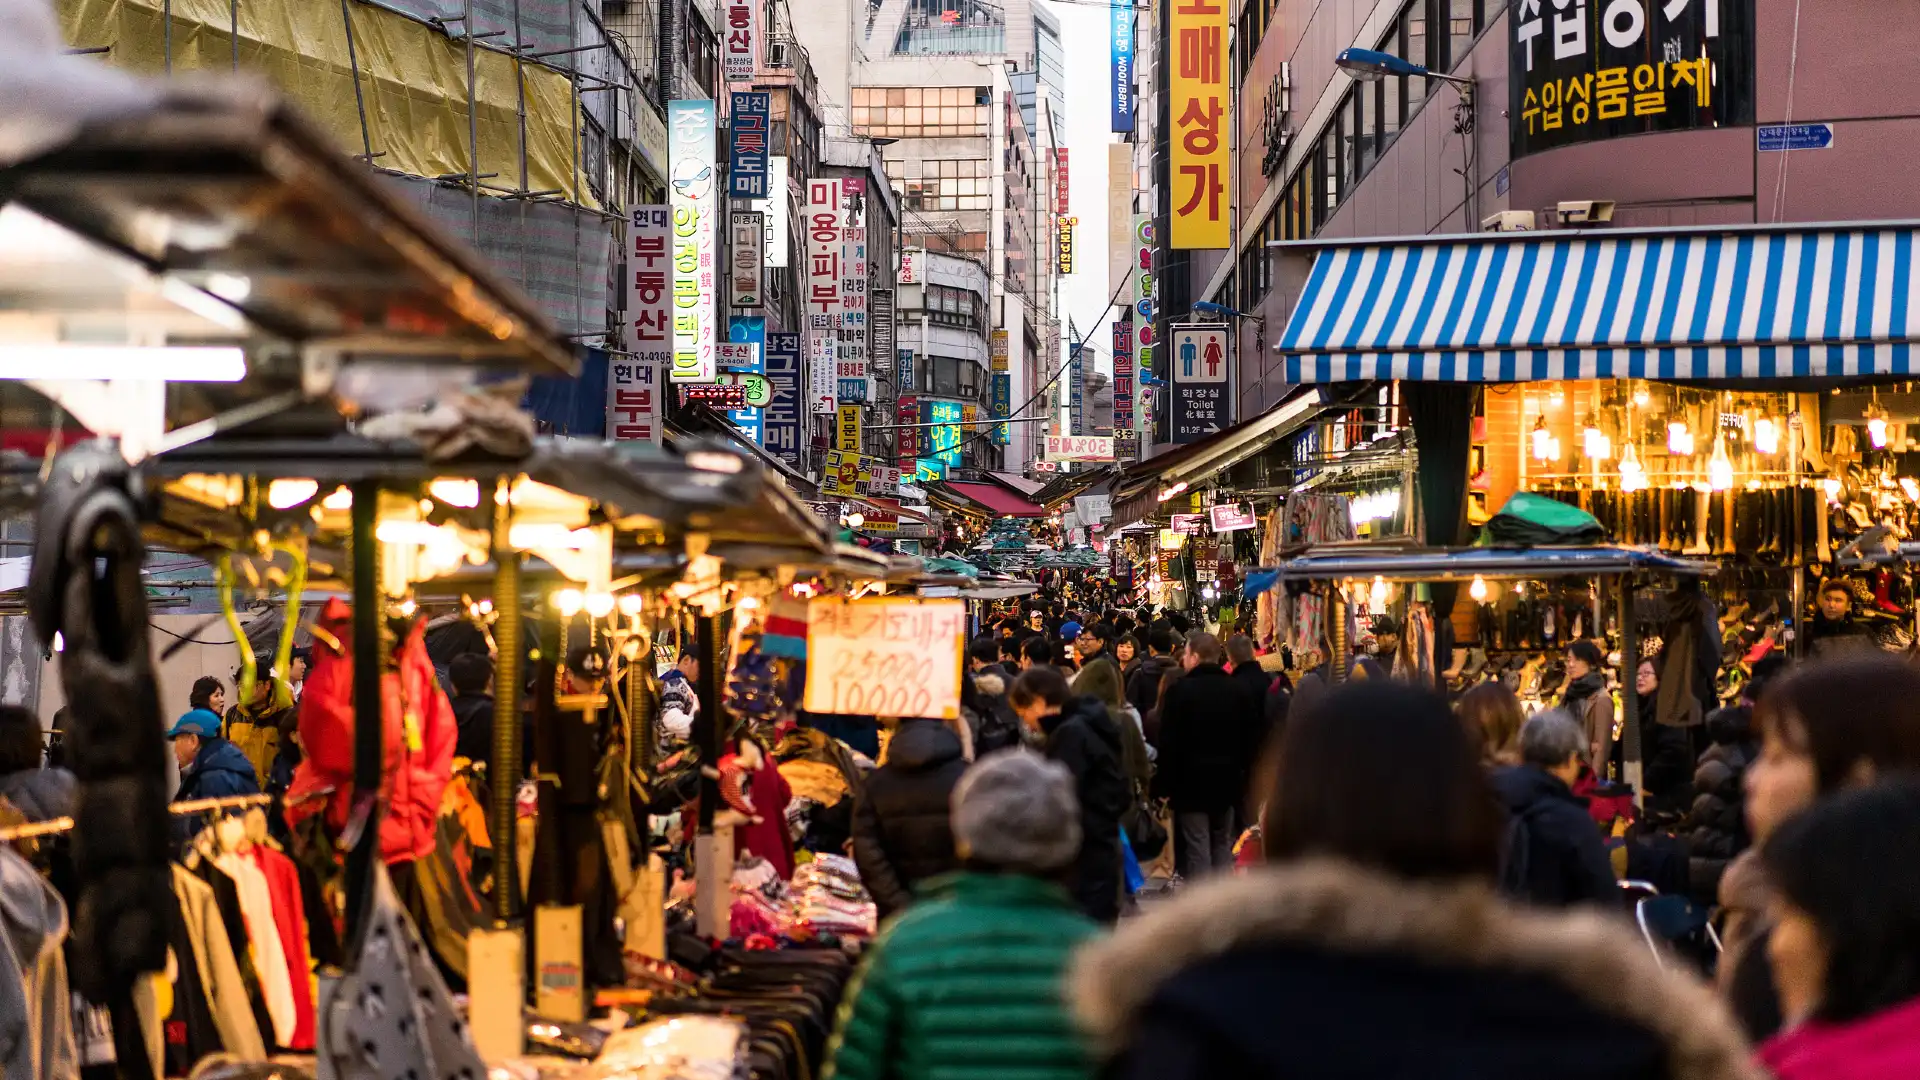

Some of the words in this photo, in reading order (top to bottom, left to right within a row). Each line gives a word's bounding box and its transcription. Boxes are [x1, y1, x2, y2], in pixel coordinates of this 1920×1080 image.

[728, 0, 750, 53] 동산
[735, 96, 766, 112] 일진
[633, 210, 667, 228] 현대
[733, 215, 761, 224] 이경자
[766, 215, 774, 264] MOLY
[842, 229, 864, 242] 적기
[735, 227, 758, 292] 미용실
[634, 236, 668, 341] 부동산
[842, 312, 865, 326] 색약
[614, 365, 653, 384] 현대
[837, 363, 864, 376] 미용재료
[1182, 389, 1219, 398] 화장실
[812, 403, 823, 411] 2F
[1187, 400, 1214, 409] Toilet
[1115, 430, 1134, 439] 3층
[872, 468, 899, 481] 미용
[830, 680, 933, 717] 10000
